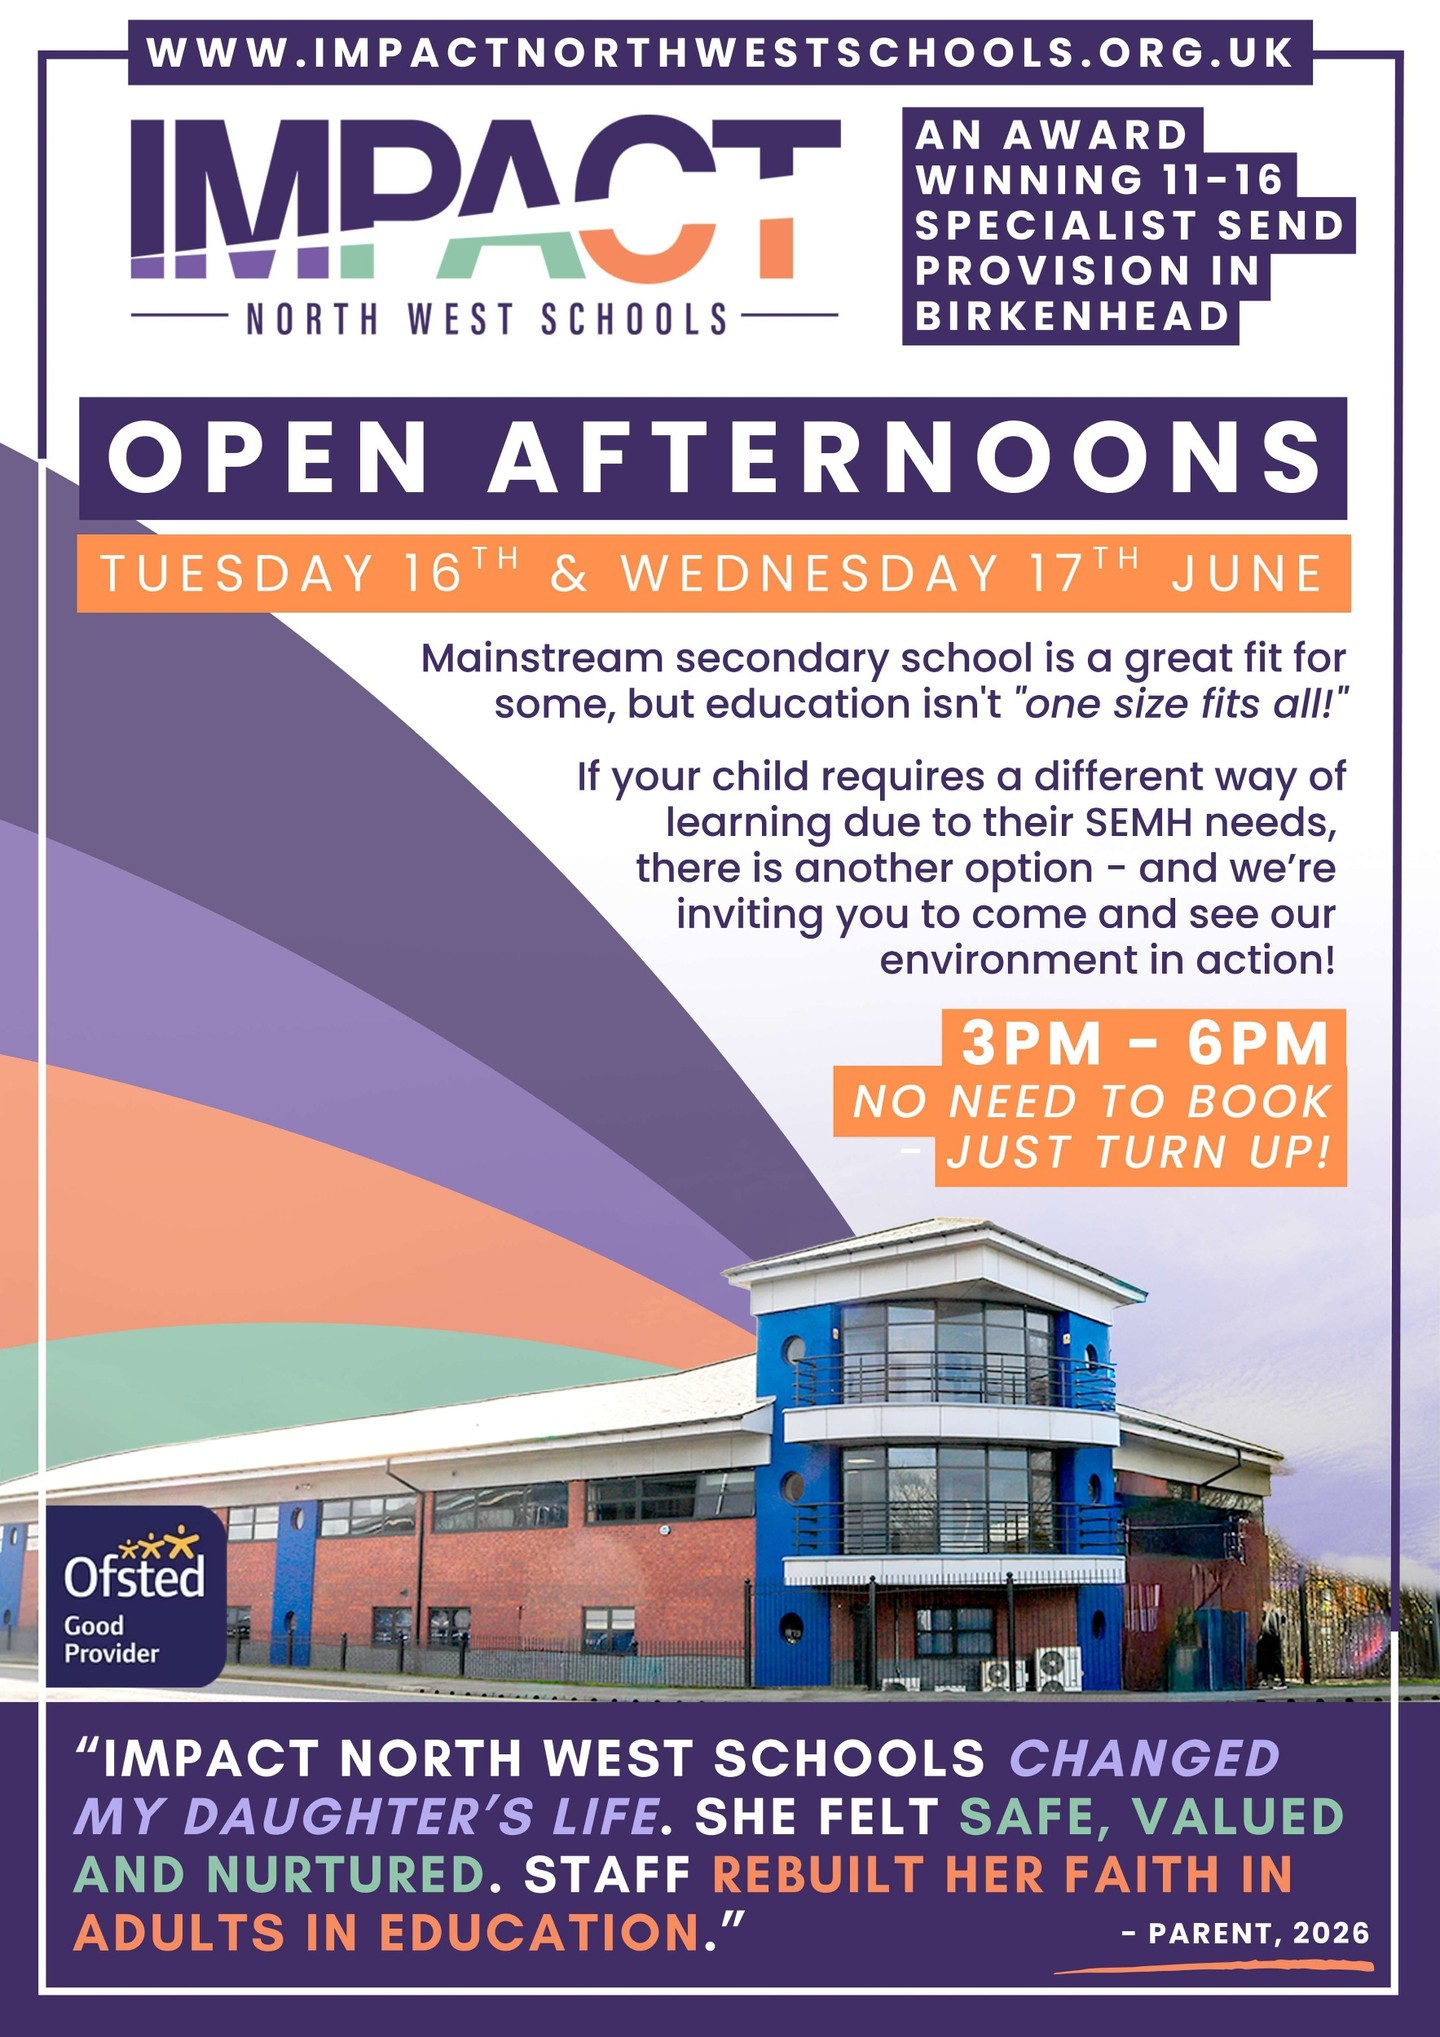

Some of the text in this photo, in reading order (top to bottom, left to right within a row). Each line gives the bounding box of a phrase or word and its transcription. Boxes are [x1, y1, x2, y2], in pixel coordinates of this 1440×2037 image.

[146, 37, 1291, 67] WWW.IMPACTNORTHWESTSCHOOLS.ORG.UK
[915, 120, 1185, 149] AN AWARD
[916, 164, 1281, 195] WINNING 11-16
[131, 114, 841, 284] IMPACT
[916, 210, 1342, 240] SPECIALIST SEND
[917, 256, 1257, 285] PROVISION IN
[248, 302, 725, 335] NORTH WEST SCHOOLS
[917, 301, 1227, 330] BIRKENHEAD
[109, 420, 1318, 493] OPEN AFTERNOONS
[100, 554, 371, 592] TUESDAY
[551, 554, 586, 592] &
[621, 554, 997, 592] WEDNESDAY
[1172, 555, 1319, 592] JUNE
[423, 641, 1346, 683] Mainstream secondary school is a great fit for
[496, 695, 615, 723] some,
[629, 688, 694, 718] but
[707, 687, 909, 718] education
[924, 685, 1001, 718] isn't
[1114, 687, 1188, 718] size
[1203, 687, 1259, 718] fits
[579, 759, 1347, 801] If your child requires a different way of
[668, 805, 1336, 847] learning due to their SEMH needs,
[636, 852, 740, 882] there
[754, 851, 782, 882] is
[796, 852, 953, 882] another
[966, 851, 1092, 892] option
[1140, 852, 1216, 882] and
[678, 897, 1336, 939] inviting you to come and see our
[881, 943, 1333, 974] environment in action!
[963, 1019, 1099, 1065] 3PM
[1189, 1019, 1326, 1065] 6PM
[854, 1084, 1332, 1118] NO NEED TO BOOK
[947, 1135, 1072, 1168] JUST
[1097, 1135, 1226, 1168] TURN
[1251, 1135, 1329, 1168] UP!
[65, 1554, 205, 1598] Ofsted
[65, 1615, 123, 1635] Good
[66, 1642, 159, 1663] Provider
[342, 1739, 519, 1777] NORTH
[543, 1739, 693, 1777] WEST
[715, 1739, 983, 1777] SCHOOLS
[1011, 1739, 1279, 1777] CHANGED
[73, 1798, 167, 1834] MY
[553, 1798, 671, 1835] LIFE.
[696, 1797, 794, 1835] SHE
[821, 1798, 938, 1834] FELT
[960, 1797, 1109, 1841] SAFE,
[1132, 1798, 1343, 1835] VALUED
[73, 1855, 1290, 1893] AND NURTURED. STAFF REBUILT HER FAITH IN
[73, 1913, 283, 1951] ADULTS
[308, 1914, 355, 1951] IN
[1150, 1923, 1281, 1947] PARENT,
[1294, 1922, 1369, 1944] 2026
